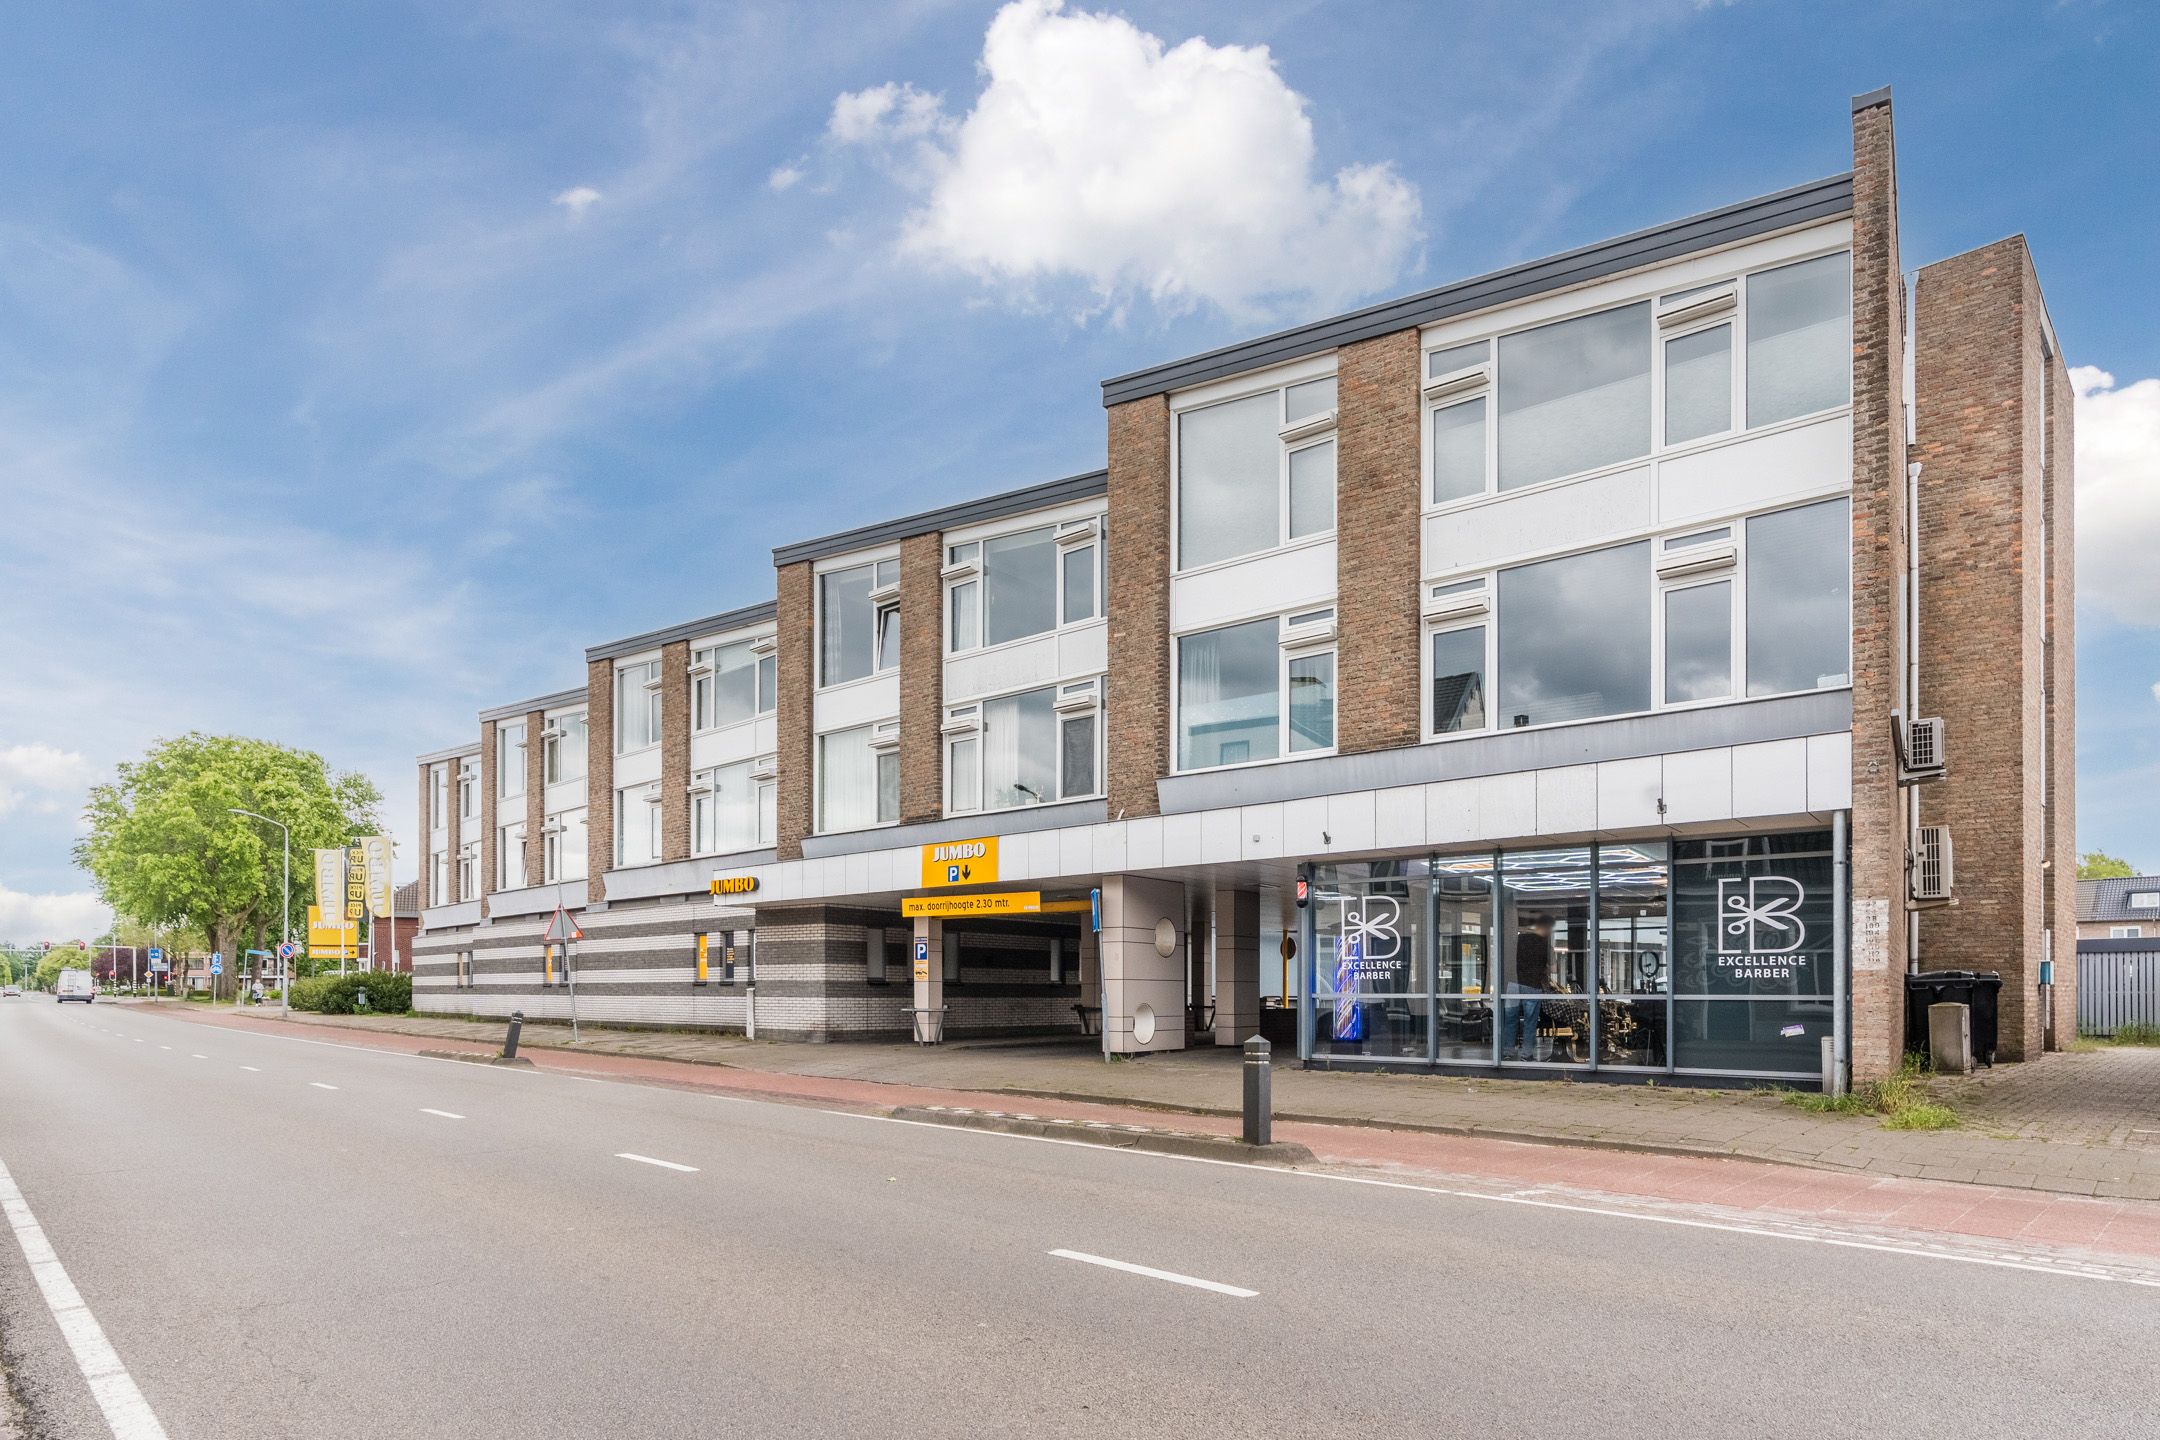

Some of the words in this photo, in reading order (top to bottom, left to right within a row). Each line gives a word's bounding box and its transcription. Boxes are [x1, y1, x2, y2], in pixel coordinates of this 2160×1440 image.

[933, 842, 986, 862] JUMBO
[950, 867, 958, 881] P
[710, 876, 757, 895] JUMBO
[909, 903, 925, 911] max.
[927, 900, 974, 911] doorrijhoogte
[995, 898, 1010, 907] mtr.
[918, 944, 926, 959] P
[1341, 961, 1401, 970] EXCELLENCE
[1718, 956, 1806, 966] EXCELLENCE
[1354, 971, 1391, 980] BARBER
[1735, 968, 1790, 979] BARBER
